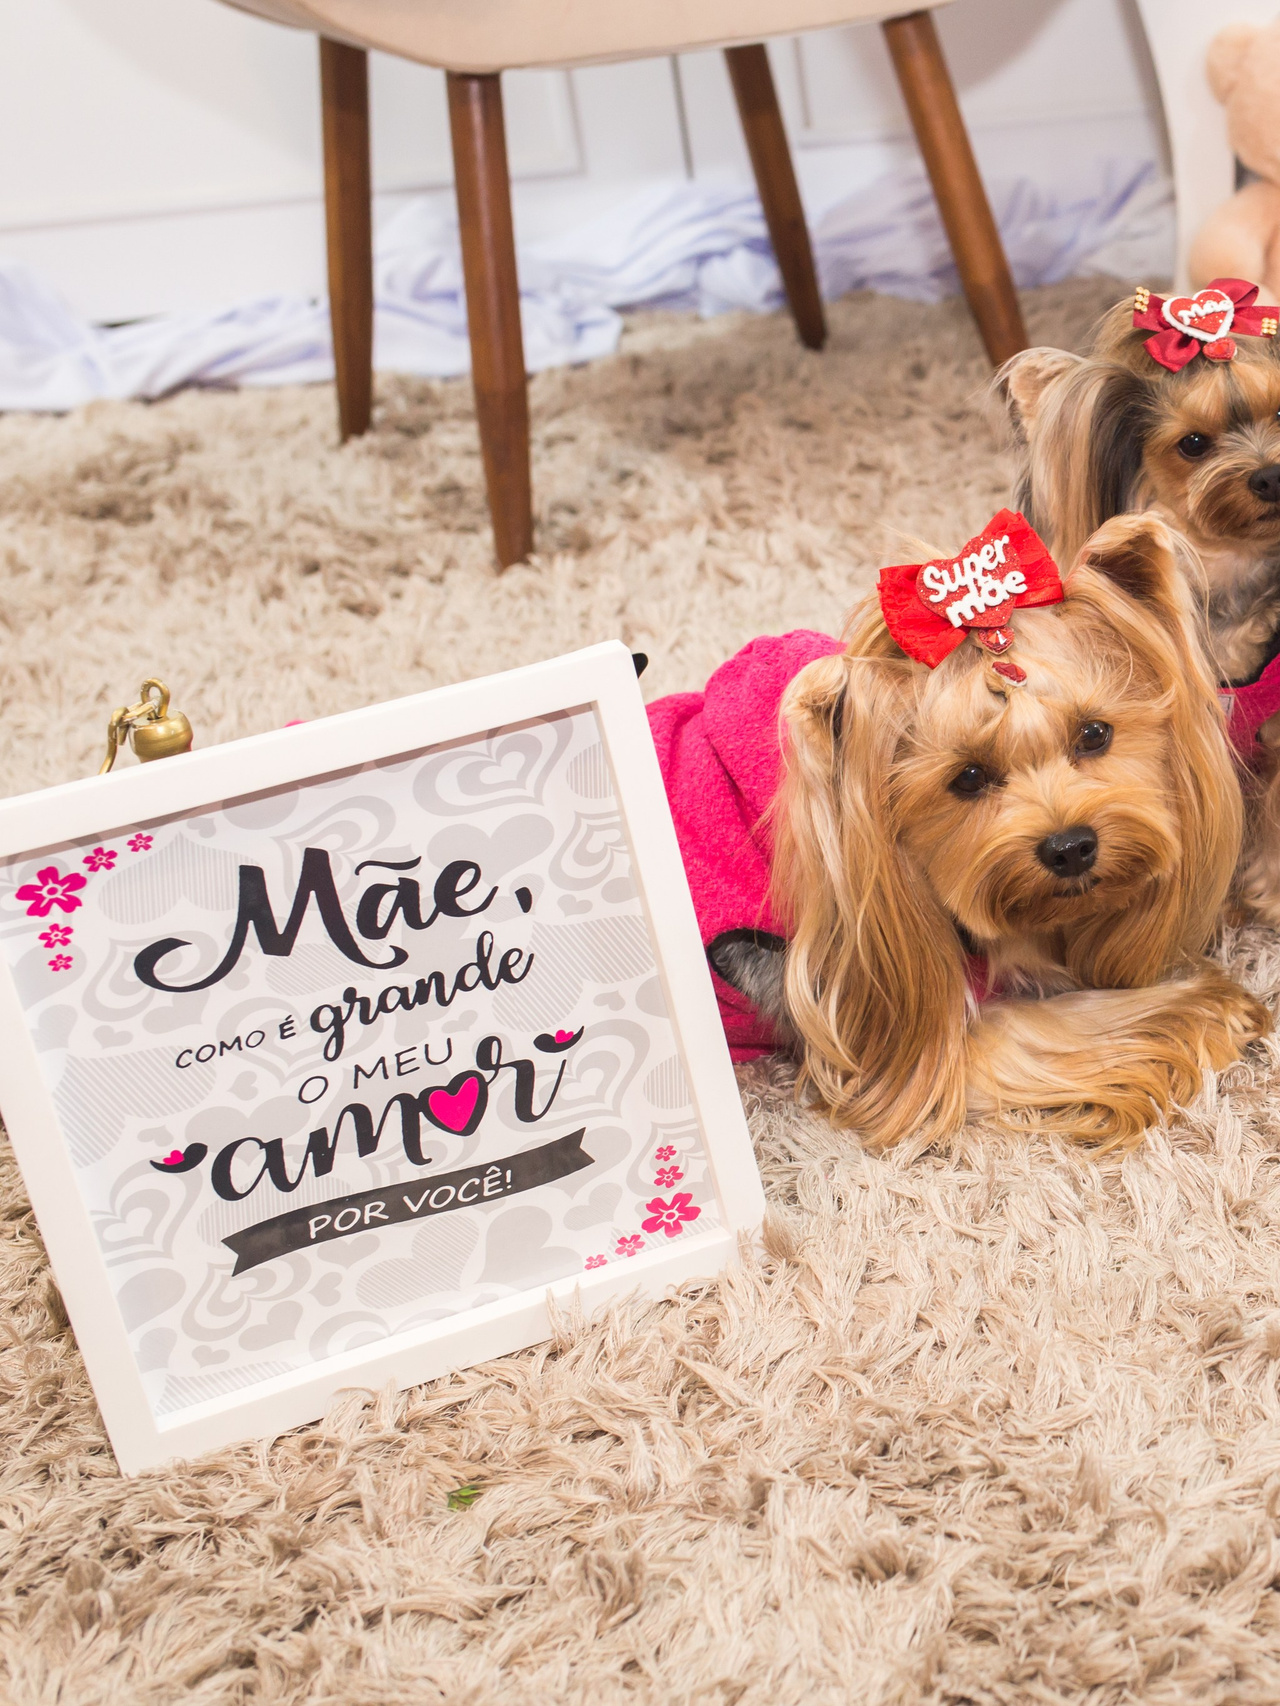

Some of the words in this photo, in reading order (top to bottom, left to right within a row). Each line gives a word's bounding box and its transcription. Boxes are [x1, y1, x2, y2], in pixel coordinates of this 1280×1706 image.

[922, 535, 1009, 603] Super
[134, 847, 533, 992] Mãe,
[175, 1029, 266, 1069] COMO
[278, 1014, 296, 1041] É
[310, 930, 535, 1061] grande
[298, 1075, 329, 1105] O
[353, 1038, 453, 1090] MEU
[308, 1201, 390, 1241] POR
[403, 1165, 513, 1215] VOCÊ!
